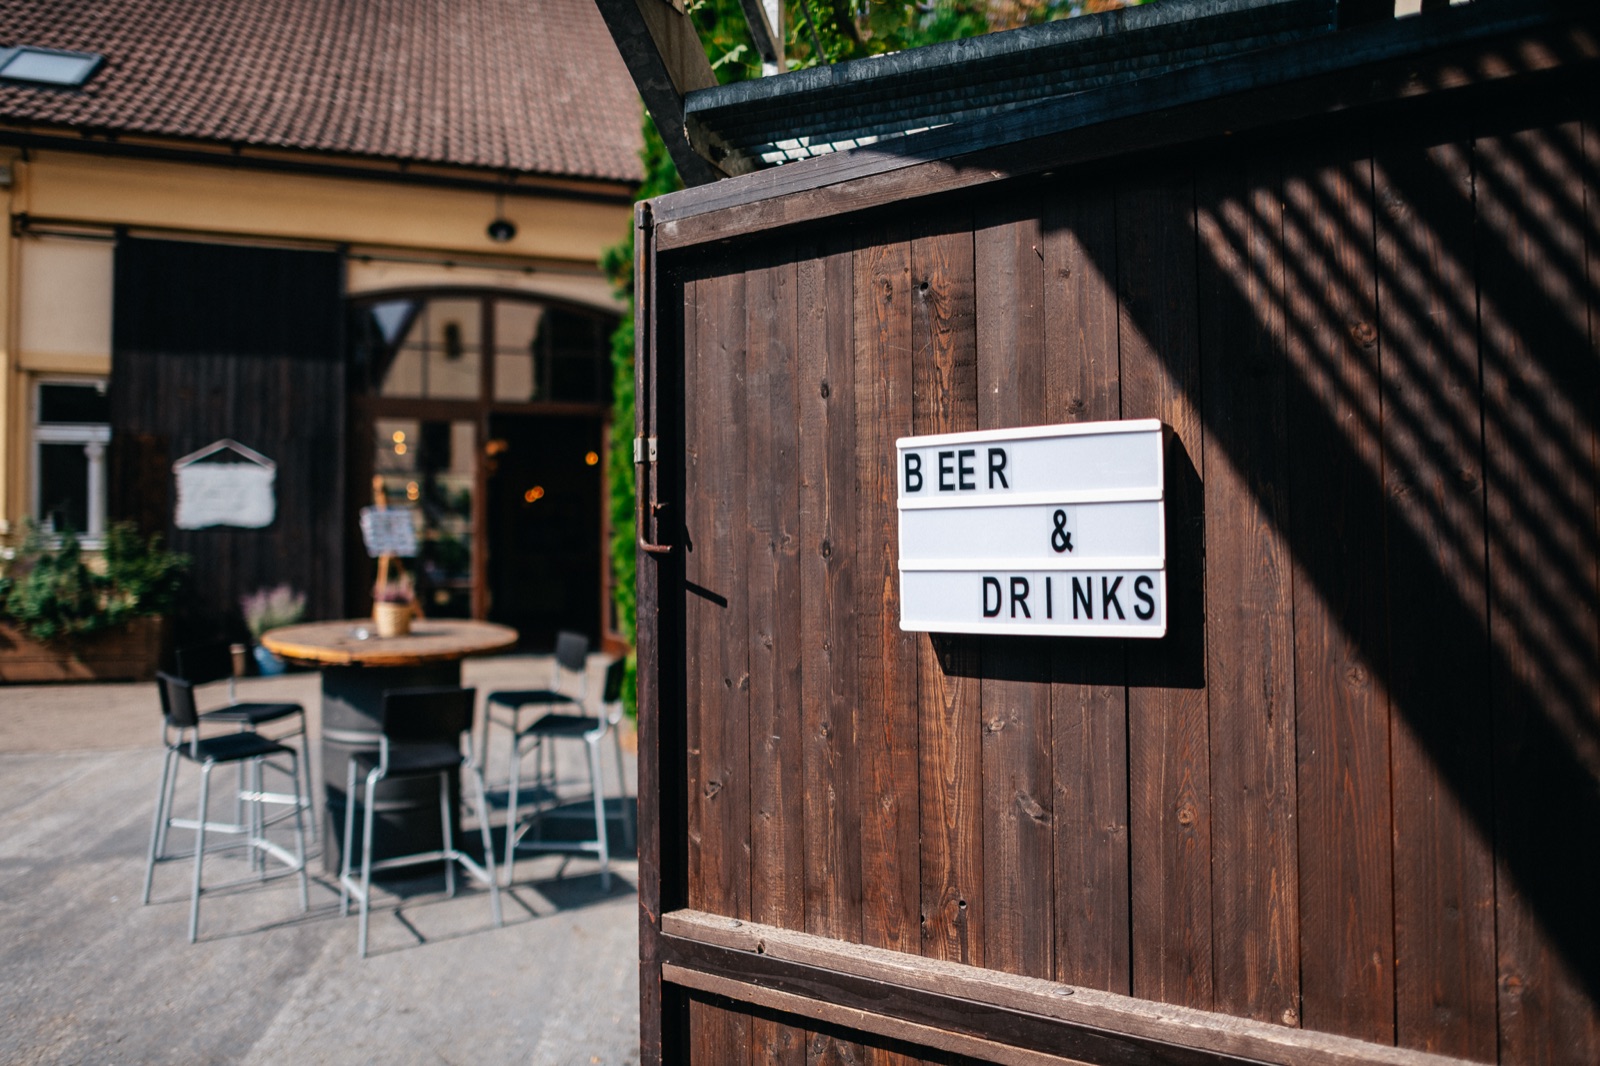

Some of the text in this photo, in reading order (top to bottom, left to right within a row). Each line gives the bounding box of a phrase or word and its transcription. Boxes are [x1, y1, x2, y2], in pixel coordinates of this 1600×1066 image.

[904, 447, 1009, 493] BEER
[1051, 509, 1074, 553] &
[982, 575, 1155, 621] DRINKS
